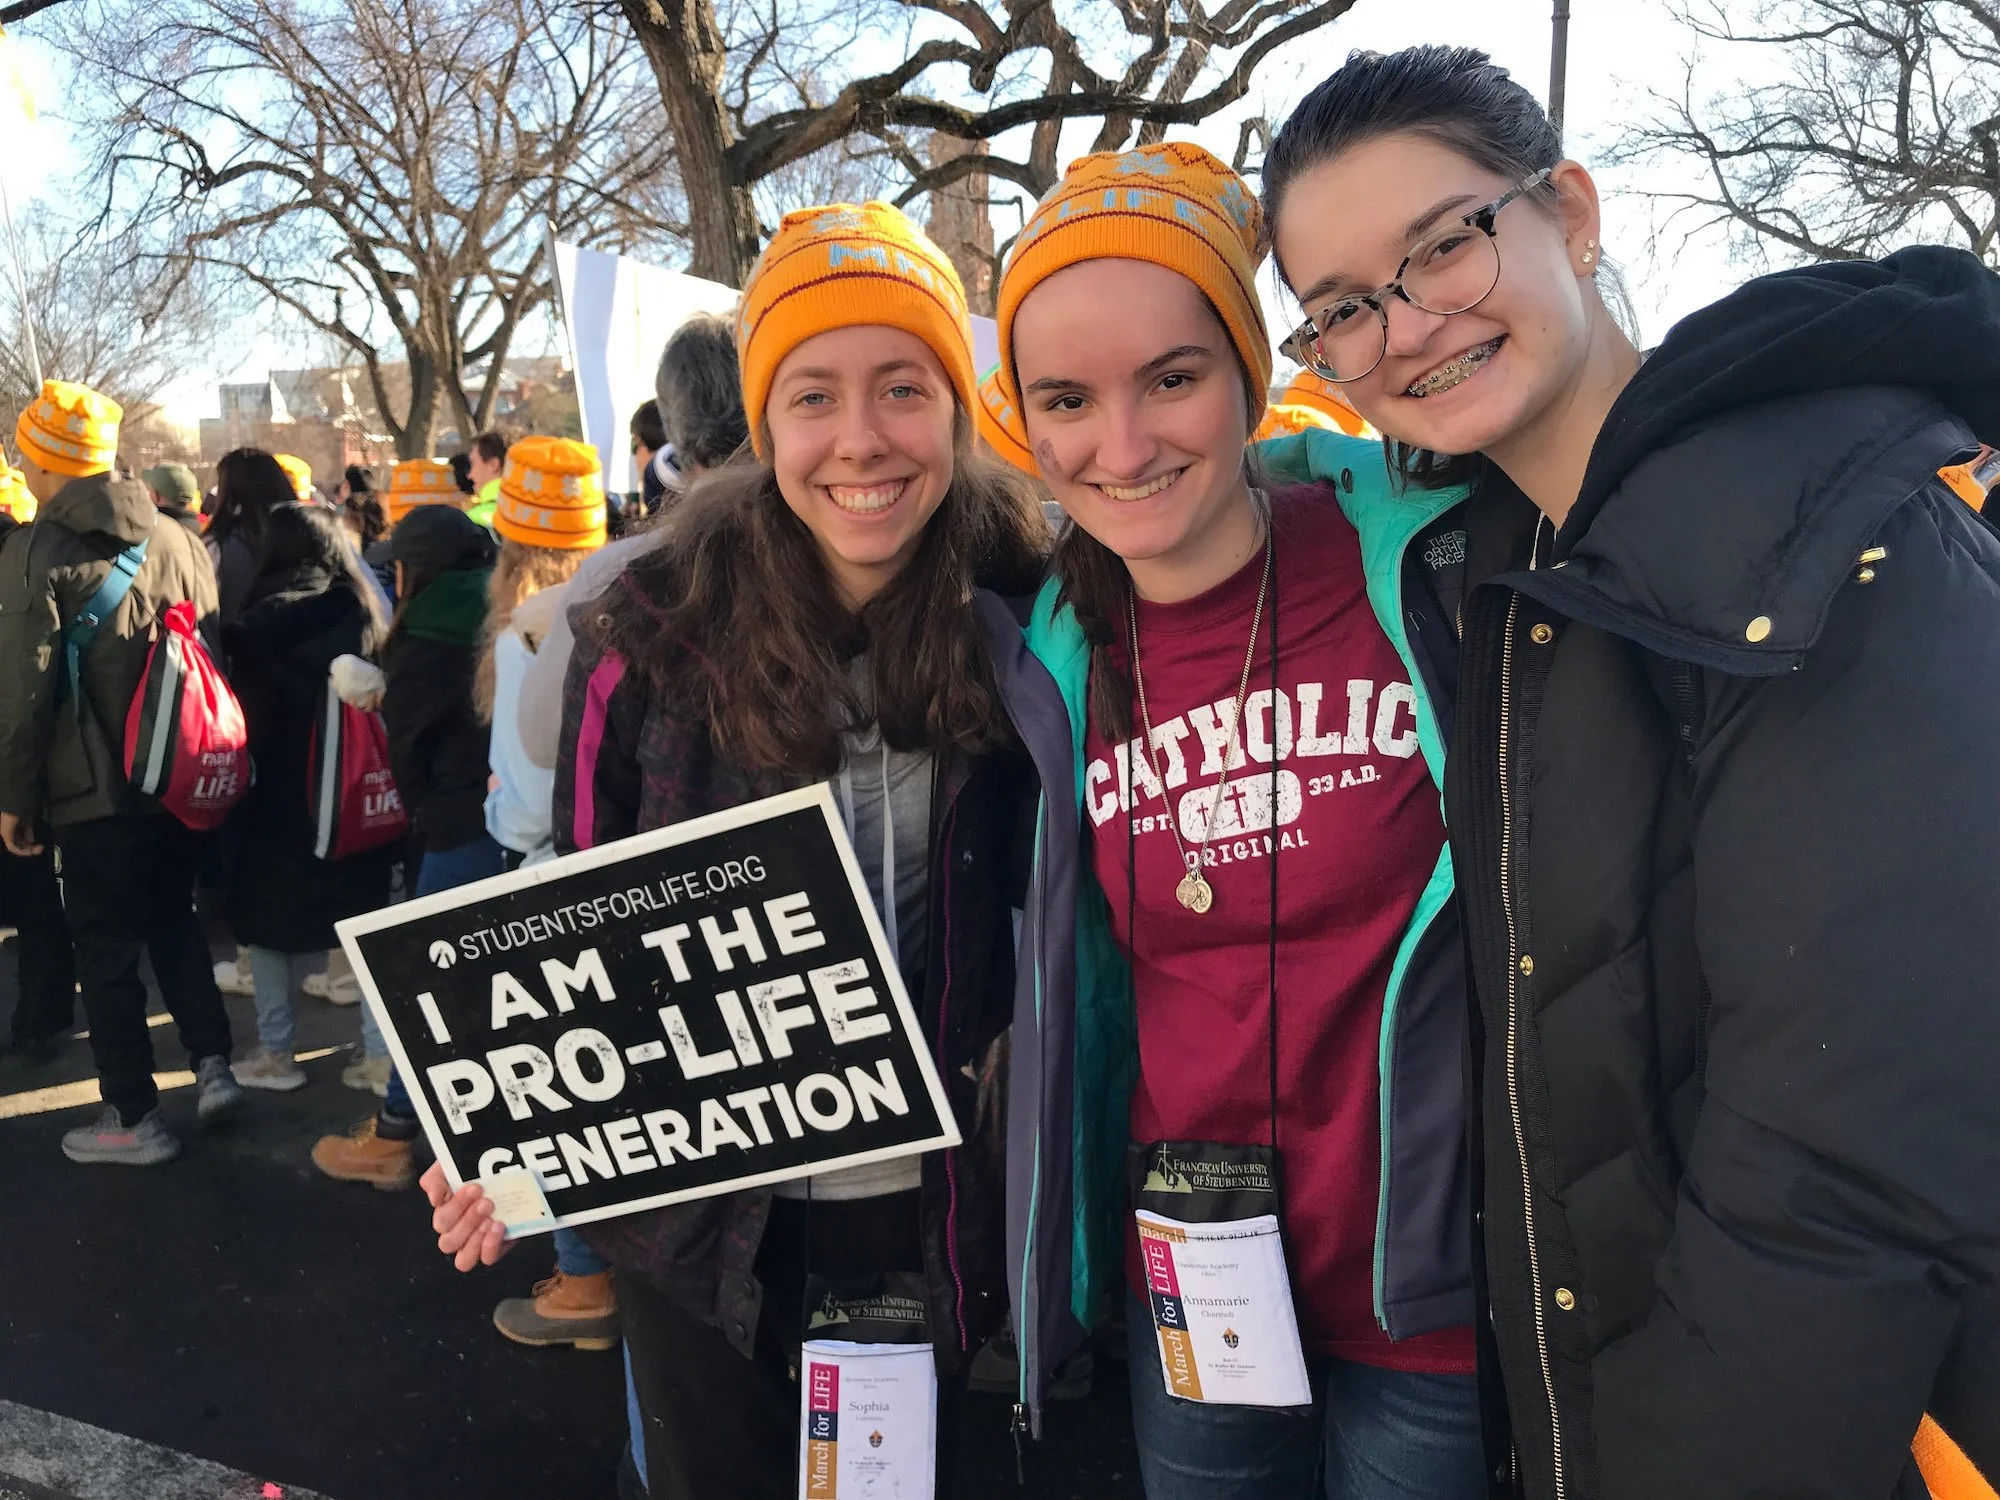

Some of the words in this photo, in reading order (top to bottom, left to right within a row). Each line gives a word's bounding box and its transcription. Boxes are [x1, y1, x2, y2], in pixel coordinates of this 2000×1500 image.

[1427, 532, 1453, 548] THE
[1431, 551, 1465, 571] FACE
[1085, 679, 1419, 828] CATHOLIC
[1308, 776, 1334, 797] 33
[1339, 764, 1382, 789] A.D.
[1184, 828, 1309, 869] ORIGINAL
[458, 855, 768, 961] STUDENTSFORLIFE.ORG
[417, 992, 452, 1045] I
[490, 947, 617, 1031] AM
[641, 891, 826, 983] THE
[426, 957, 893, 1136] PRO-LIFE
[478, 1058, 909, 1193] GENERATION
[1149, 1244, 1172, 1295] LIFE
[1162, 1297, 1178, 1325] for
[1184, 1294, 1249, 1307] Annamarie
[1167, 1330, 1191, 1387] March
[814, 1369, 830, 1411] LIFE
[848, 1400, 890, 1414] Sophia
[813, 1414, 829, 1437] for
[812, 1442, 828, 1490] March
